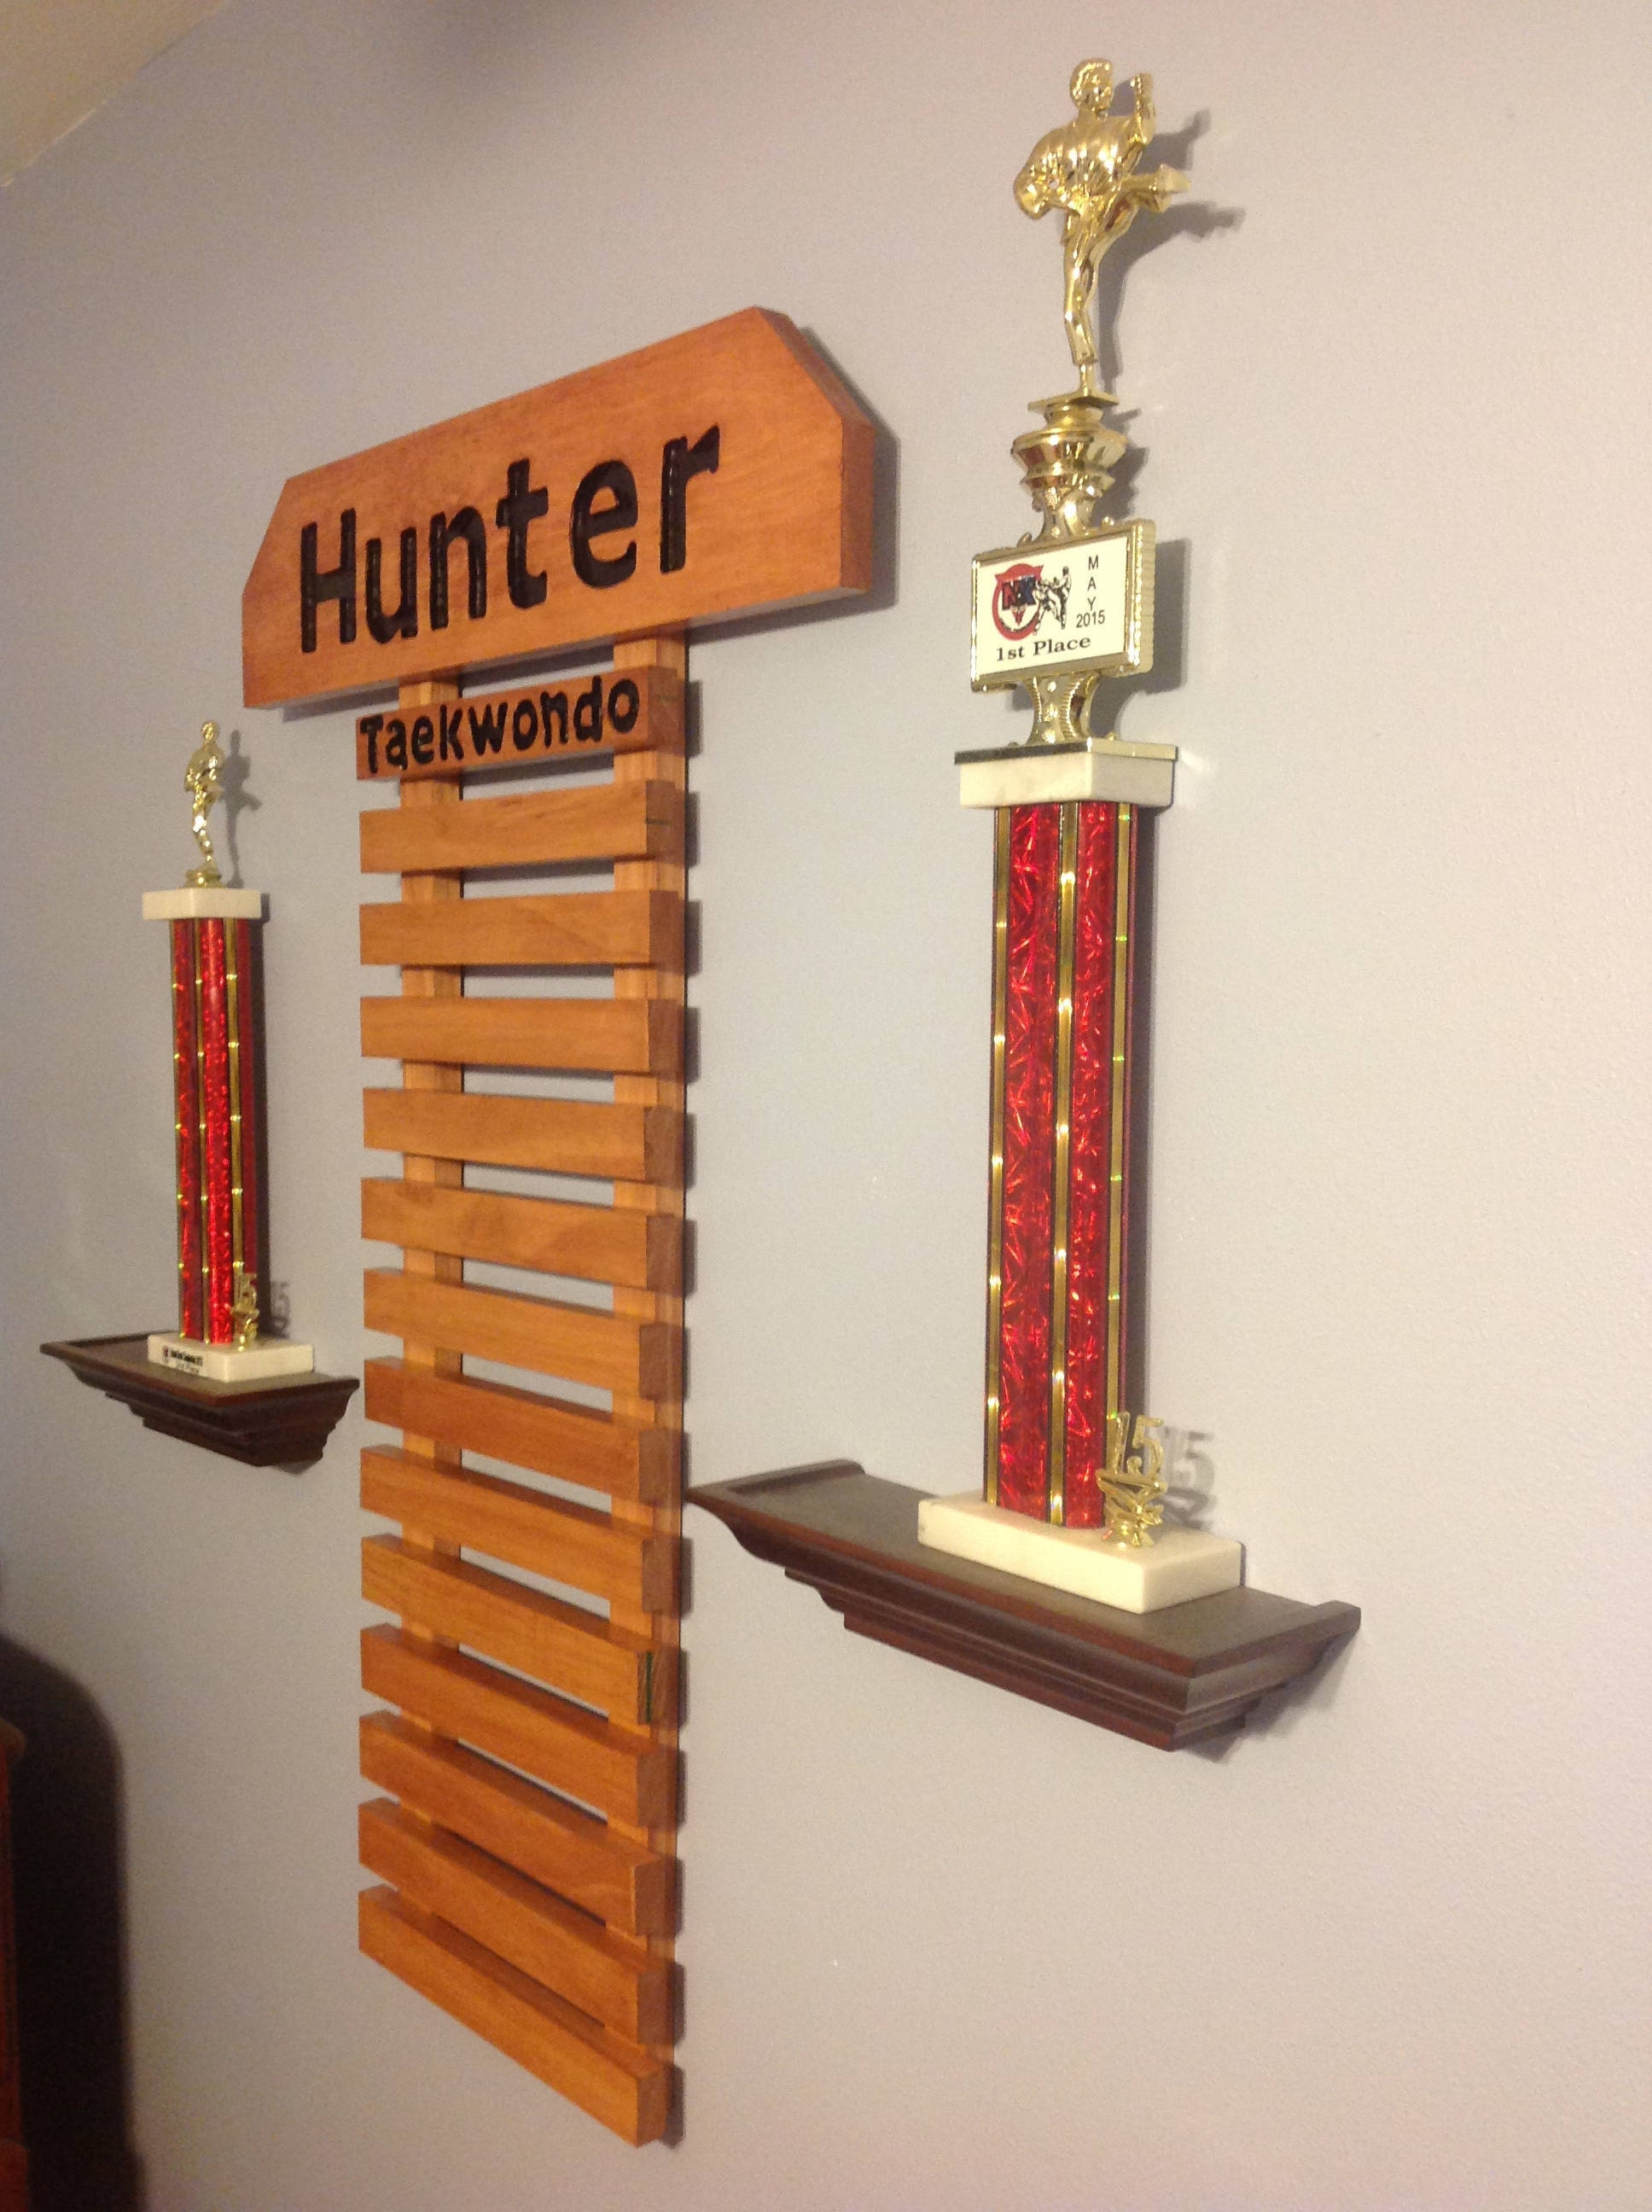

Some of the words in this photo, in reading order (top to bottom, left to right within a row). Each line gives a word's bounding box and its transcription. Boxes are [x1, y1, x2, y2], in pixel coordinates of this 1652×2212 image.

[300, 424, 720, 654] Hunter
[997, 646, 1025, 661] 1st
[1033, 637, 1091, 655] Place
[1076, 609, 1106, 628] 2015
[359, 675, 640, 773] Taekwondo
